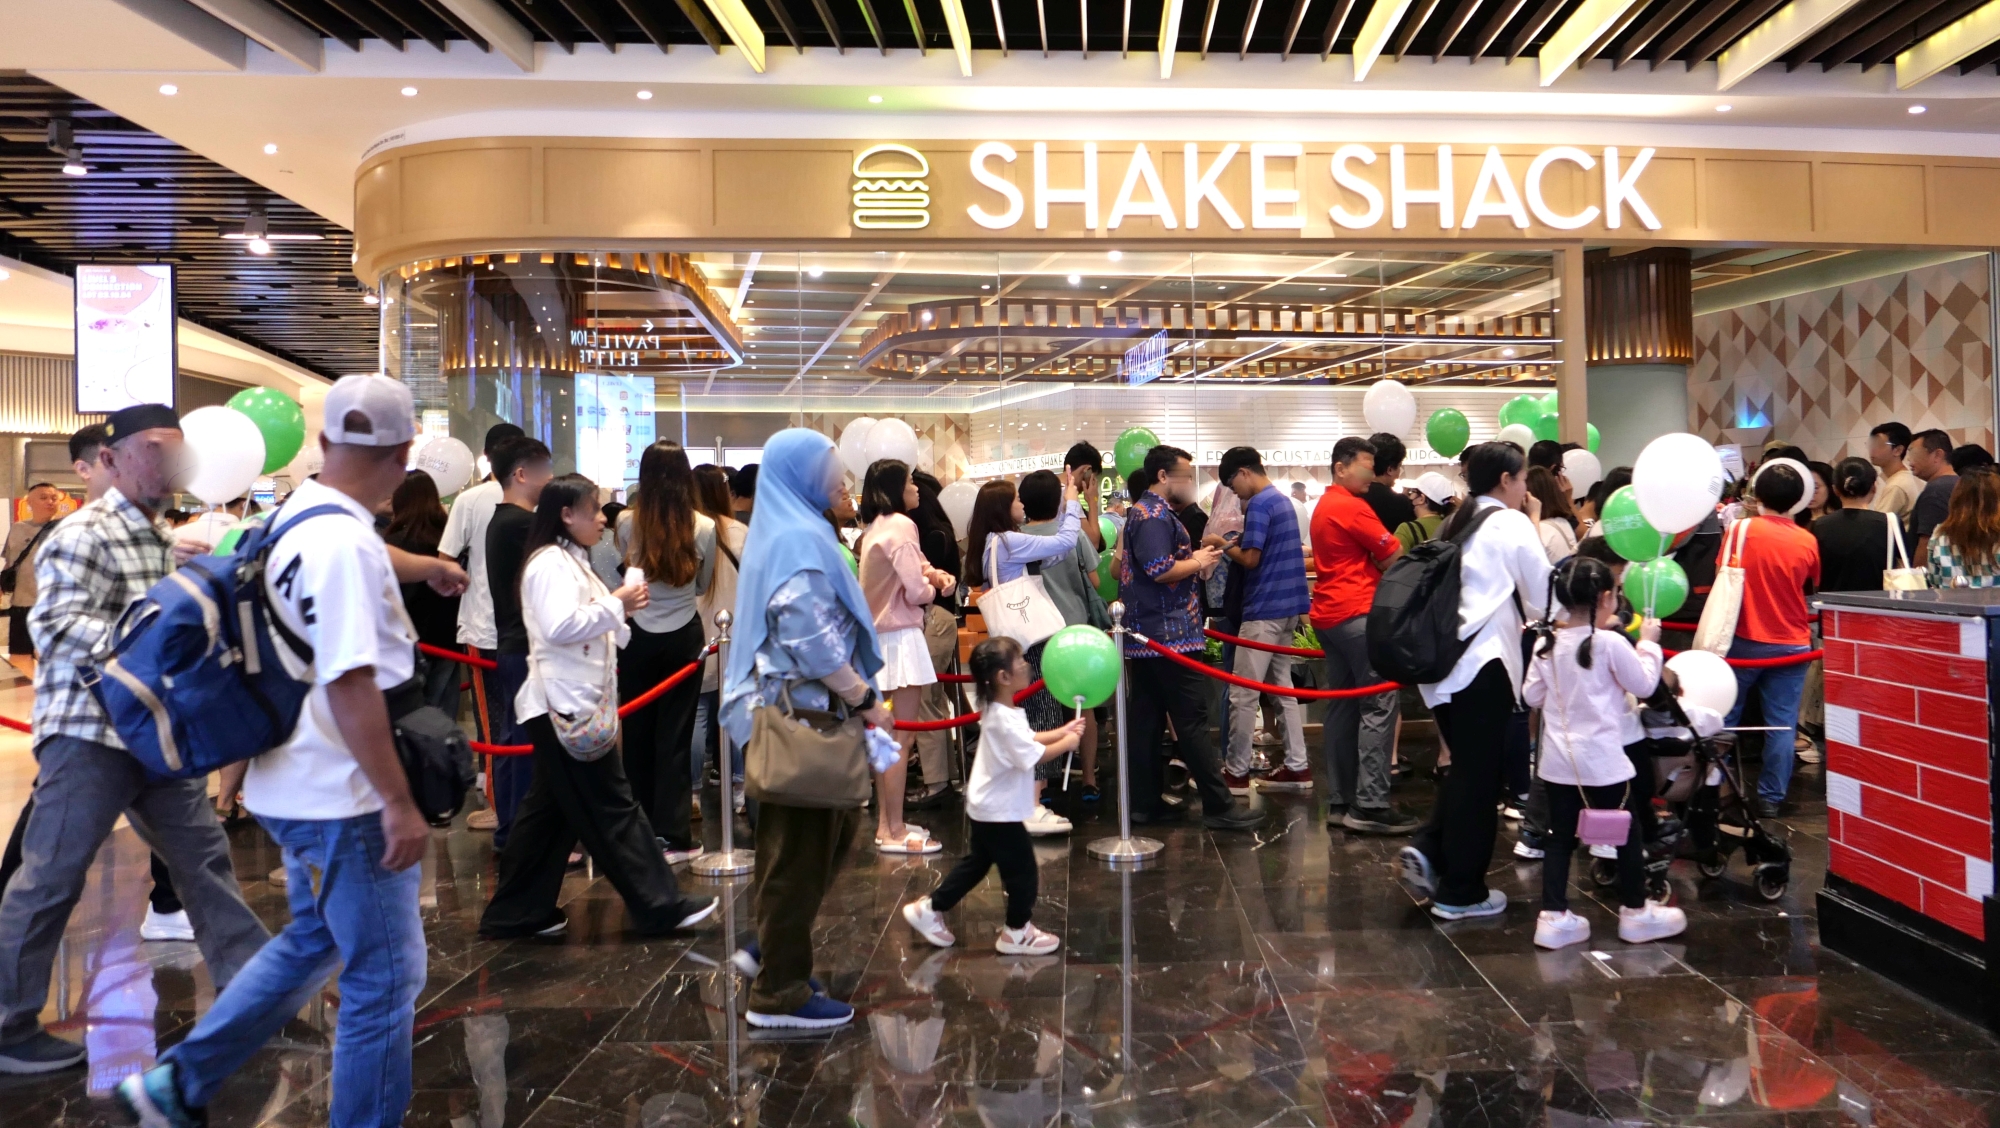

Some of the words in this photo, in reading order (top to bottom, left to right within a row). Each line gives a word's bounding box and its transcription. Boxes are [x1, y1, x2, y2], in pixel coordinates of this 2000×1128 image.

[966, 141, 1306, 230] SHAKE
[1328, 143, 1662, 230] SHACK
[428, 456, 451, 468] SHAKE
[1040, 453, 1065, 468] SHAKE
[1272, 450, 1331, 462] CUSTAR
[426, 462, 448, 474] SHACK
